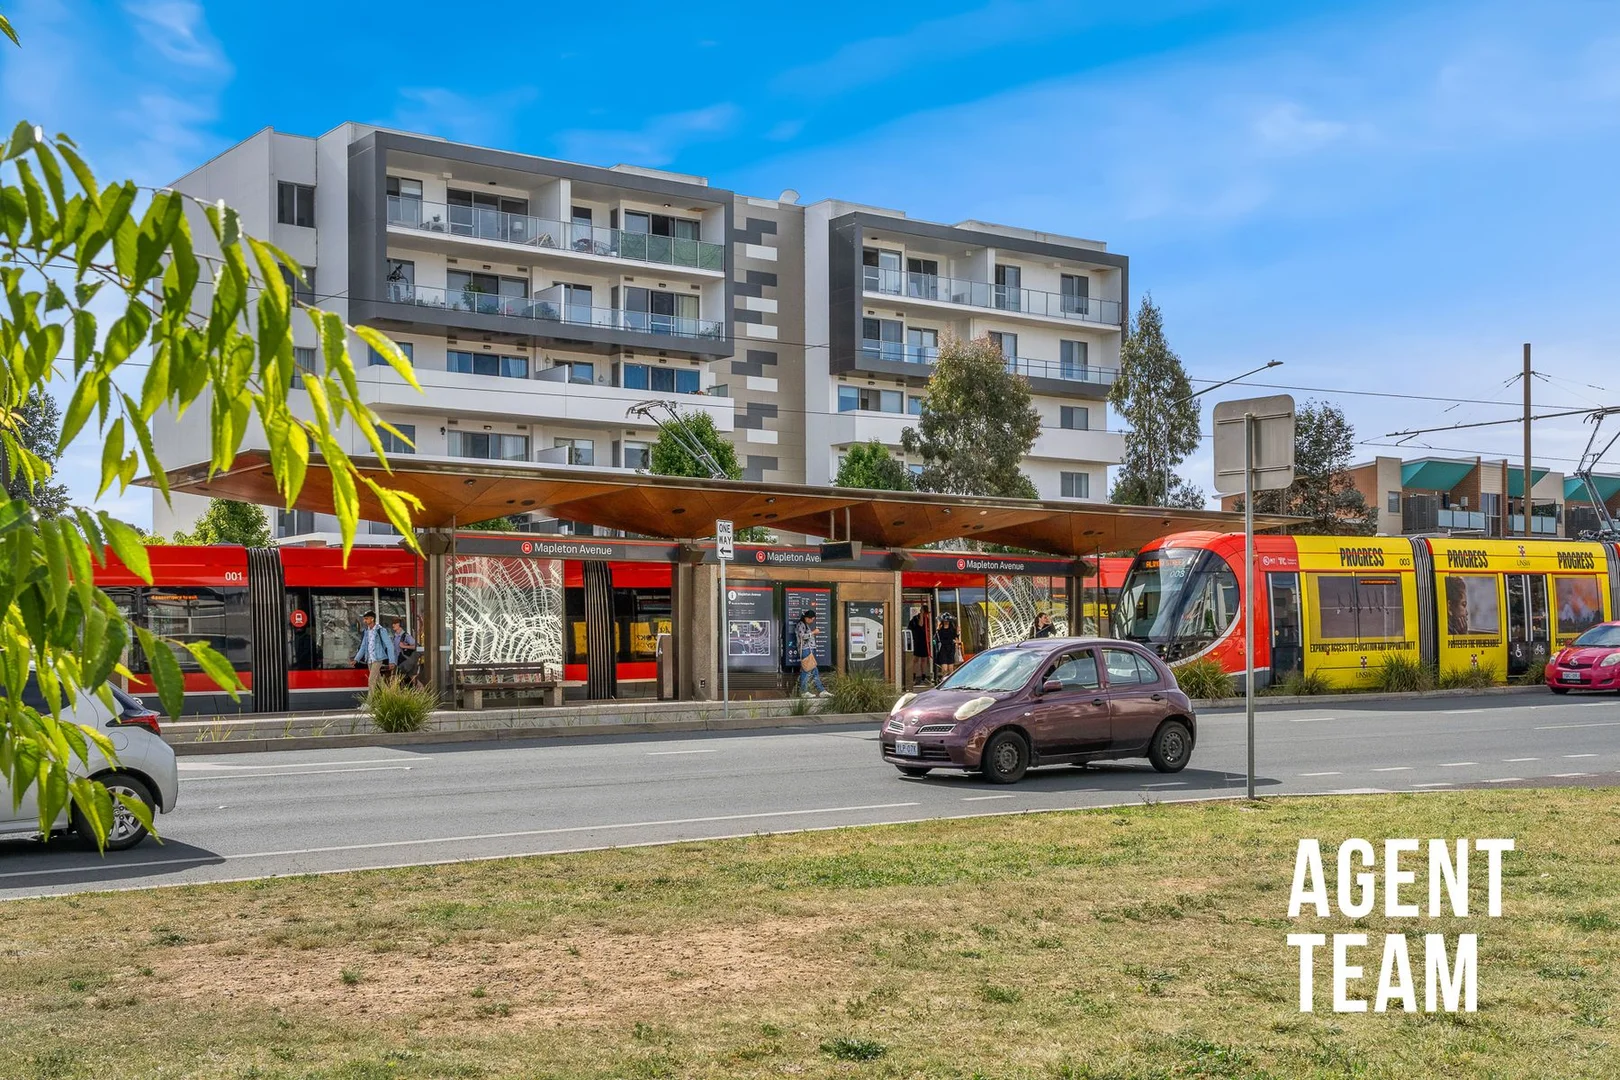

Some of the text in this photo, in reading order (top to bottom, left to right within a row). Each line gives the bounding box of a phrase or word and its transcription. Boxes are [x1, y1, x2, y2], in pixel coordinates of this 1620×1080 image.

[718, 523, 731, 534] ONE
[719, 536, 732, 545] WAY
[534, 542, 612, 555] Mapleton Avenue
[767, 551, 804, 563] Mapleton
[1340, 547, 1384, 567] PROGRESS
[1399, 558, 1411, 566] 003
[1447, 549, 1488, 568] PROGRESS
[1557, 551, 1594, 569] PROGRESS
[966, 560, 1025, 571] Mapleton Avenue
[225, 571, 243, 581] 001
